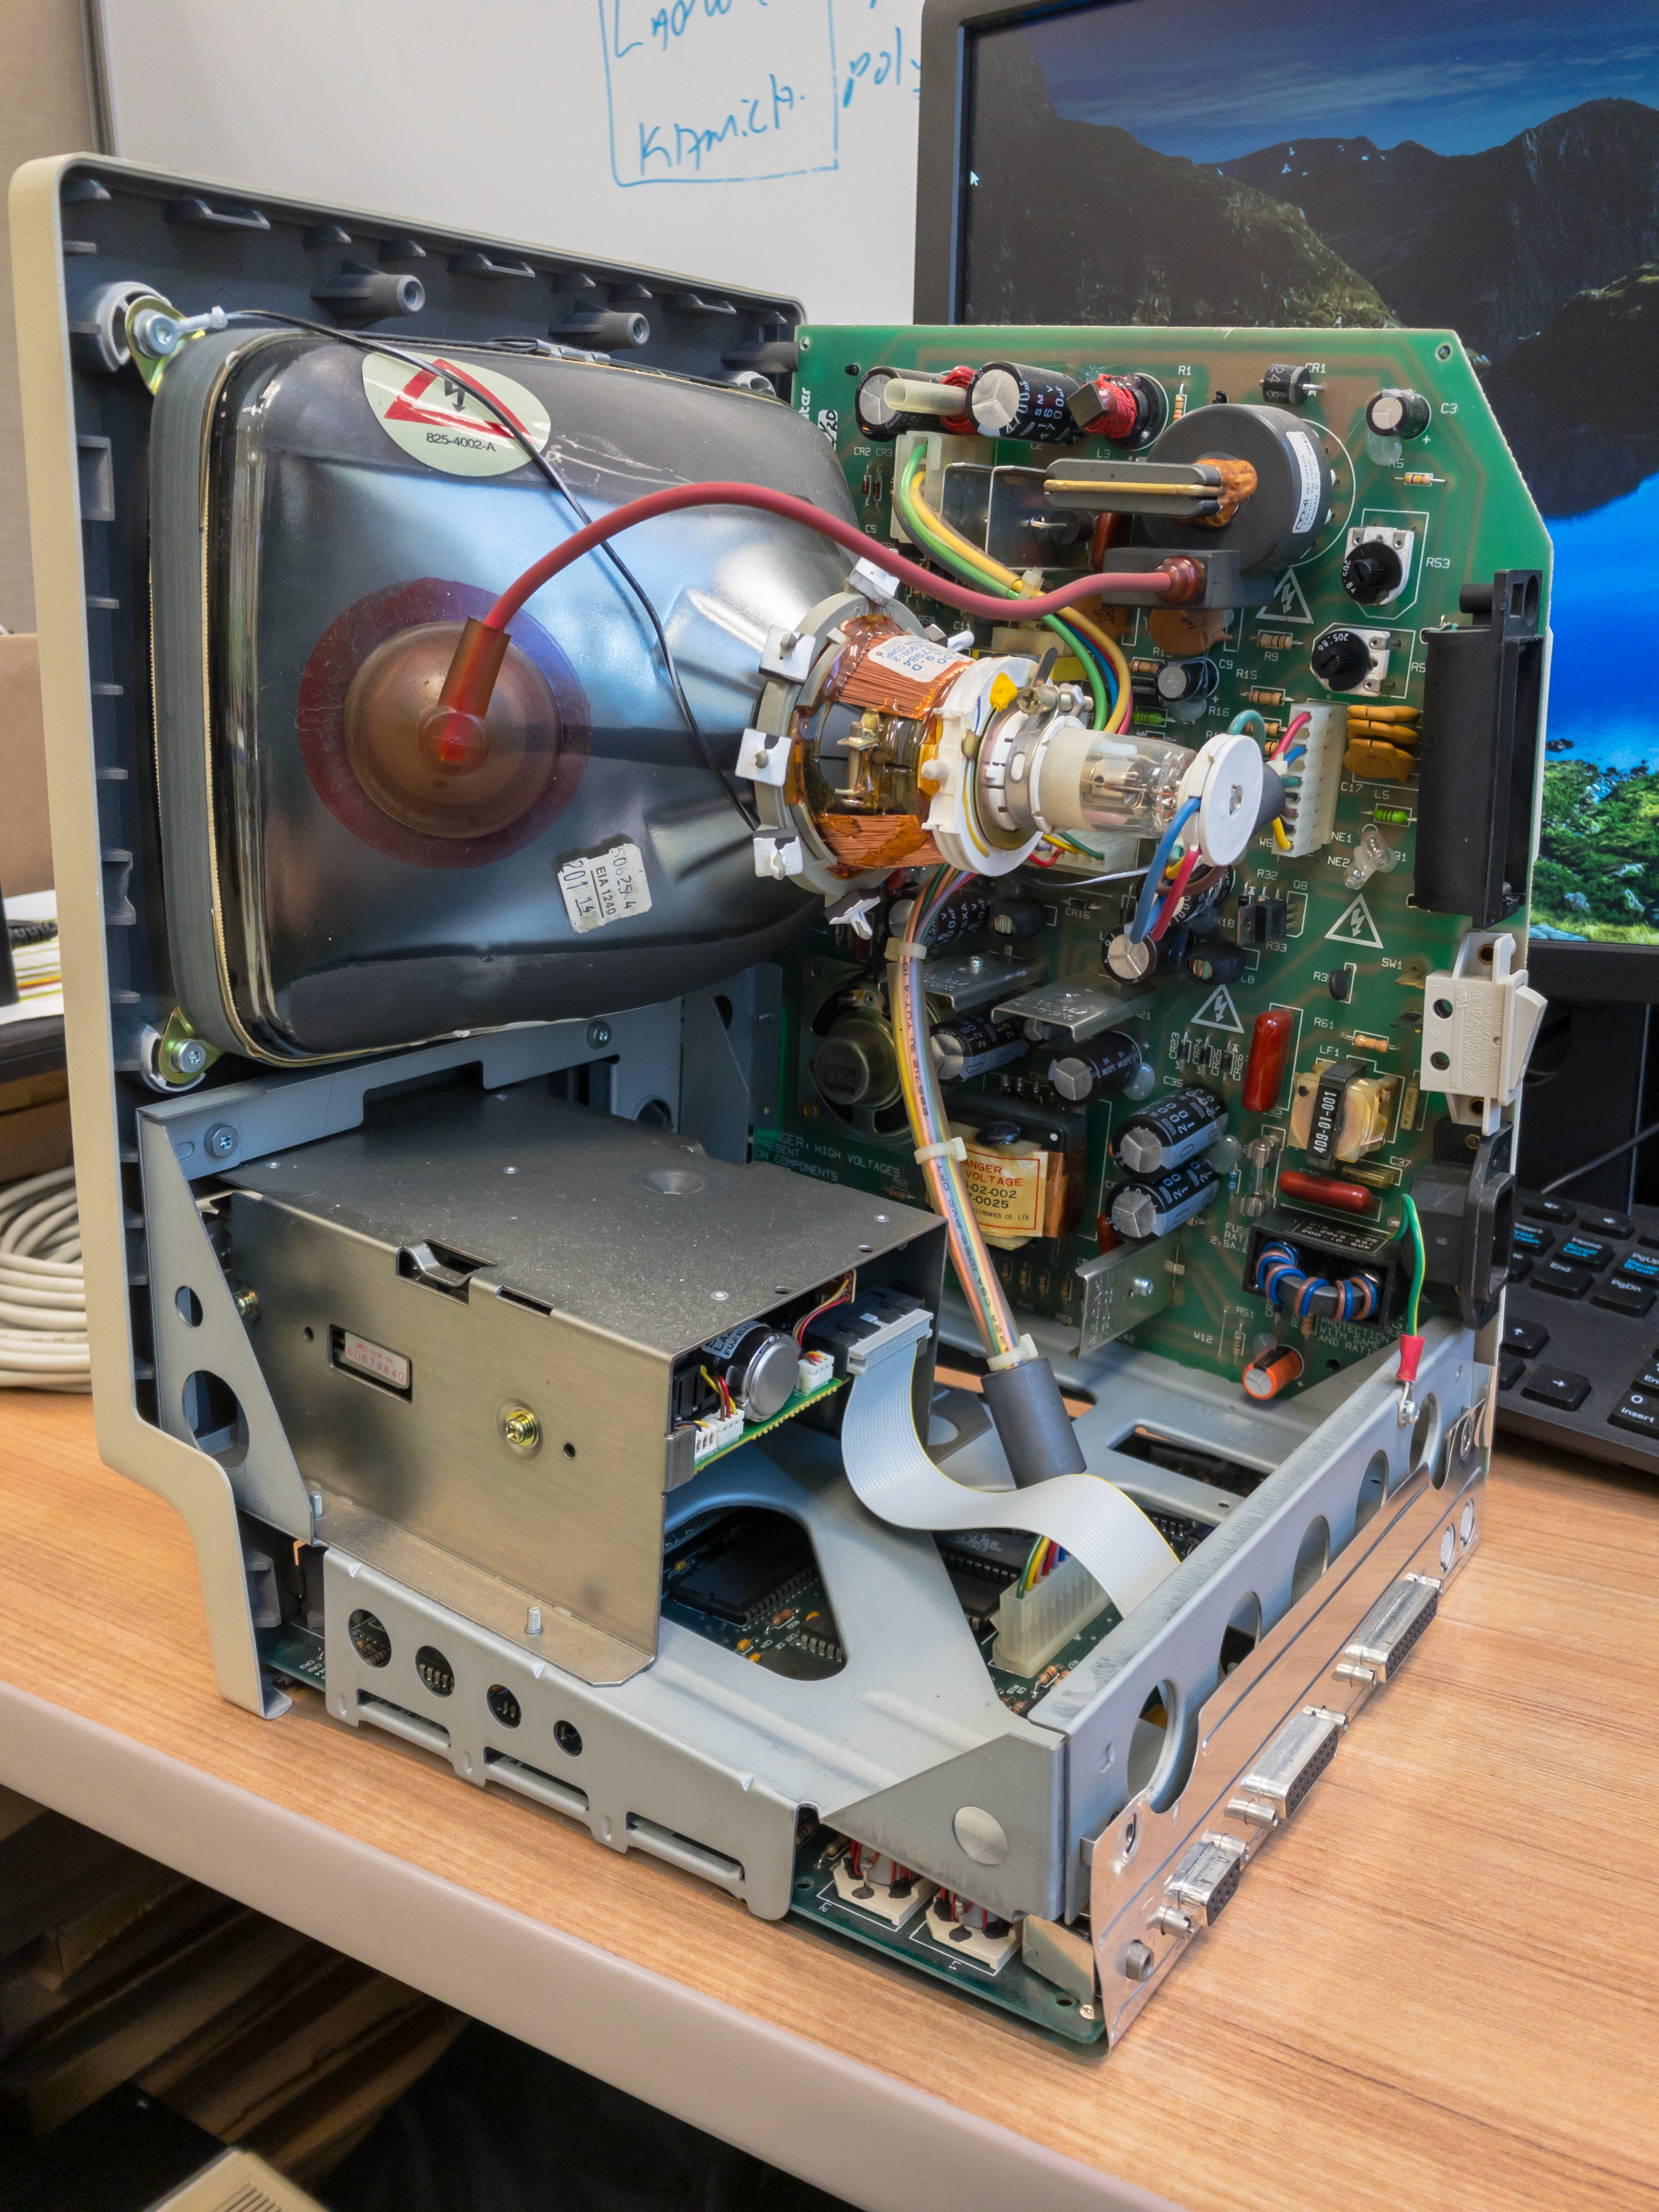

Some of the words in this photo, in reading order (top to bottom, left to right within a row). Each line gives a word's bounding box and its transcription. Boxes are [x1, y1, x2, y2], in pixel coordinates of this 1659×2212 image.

[1178, 365, 1192, 376] R1
[1305, 362, 1327, 374] CR1
[1441, 403, 1458, 414] C3
[426, 432, 496, 452] 825-4002-A
[854, 447, 871, 456] CR2
[876, 448, 893, 457] CR3
[1097, 449, 1111, 459] L3
[1426, 557, 1450, 569] R53
[1264, 652, 1279, 662] R9
[1218, 659, 1233, 669] C9
[1235, 669, 1257, 680] R15
[1208, 706, 1229, 717] R16
[1340, 782, 1363, 793] C17
[1374, 789, 1390, 800] L5
[1331, 832, 1352, 843] NE1
[1327, 855, 1351, 867] NE2
[1257, 868, 1278, 881] R32
[595, 866, 609, 887] EIA
[602, 889, 617, 915] 1240
[1293, 879, 1308, 891] Q8
[1065, 907, 1091, 920] CR16
[1266, 941, 1288, 952] R33
[1381, 957, 1403, 970] SW1
[1313, 1017, 1334, 1030] R61
[1169, 1031, 1180, 1059] CR23
[1210, 1048, 1222, 1076] CR25
[1233, 1053, 1244, 1081] CR26
[1319, 1045, 1340, 1057] LF1
[1163, 1076, 1183, 1088] C35
[1313, 1091, 1338, 1154] 409-01-001
[815, 1145, 841, 1160] HIGH
[847, 1154, 901, 1178] VOLTAGES
[1389, 1155, 1412, 1168] C37
[774, 1154, 838, 1182] COMPONENTS
[965, 1169, 1023, 1187] VOLTAGE
[948, 1198, 962, 1229] PVC
[1550, 1261, 1572, 1273] End
[1235, 1306, 1255, 1319] R51
[1321, 1317, 1390, 1344] PROTECTION
[1193, 1331, 1213, 1345] W12
[1318, 1335, 1339, 1347] AND
[1319, 1324, 1347, 1340] WITH
[1353, 1335, 1381, 1350] SAME
[724, 1338, 740, 1356] FUJI
[1621, 1406, 1656, 1424] Insert
